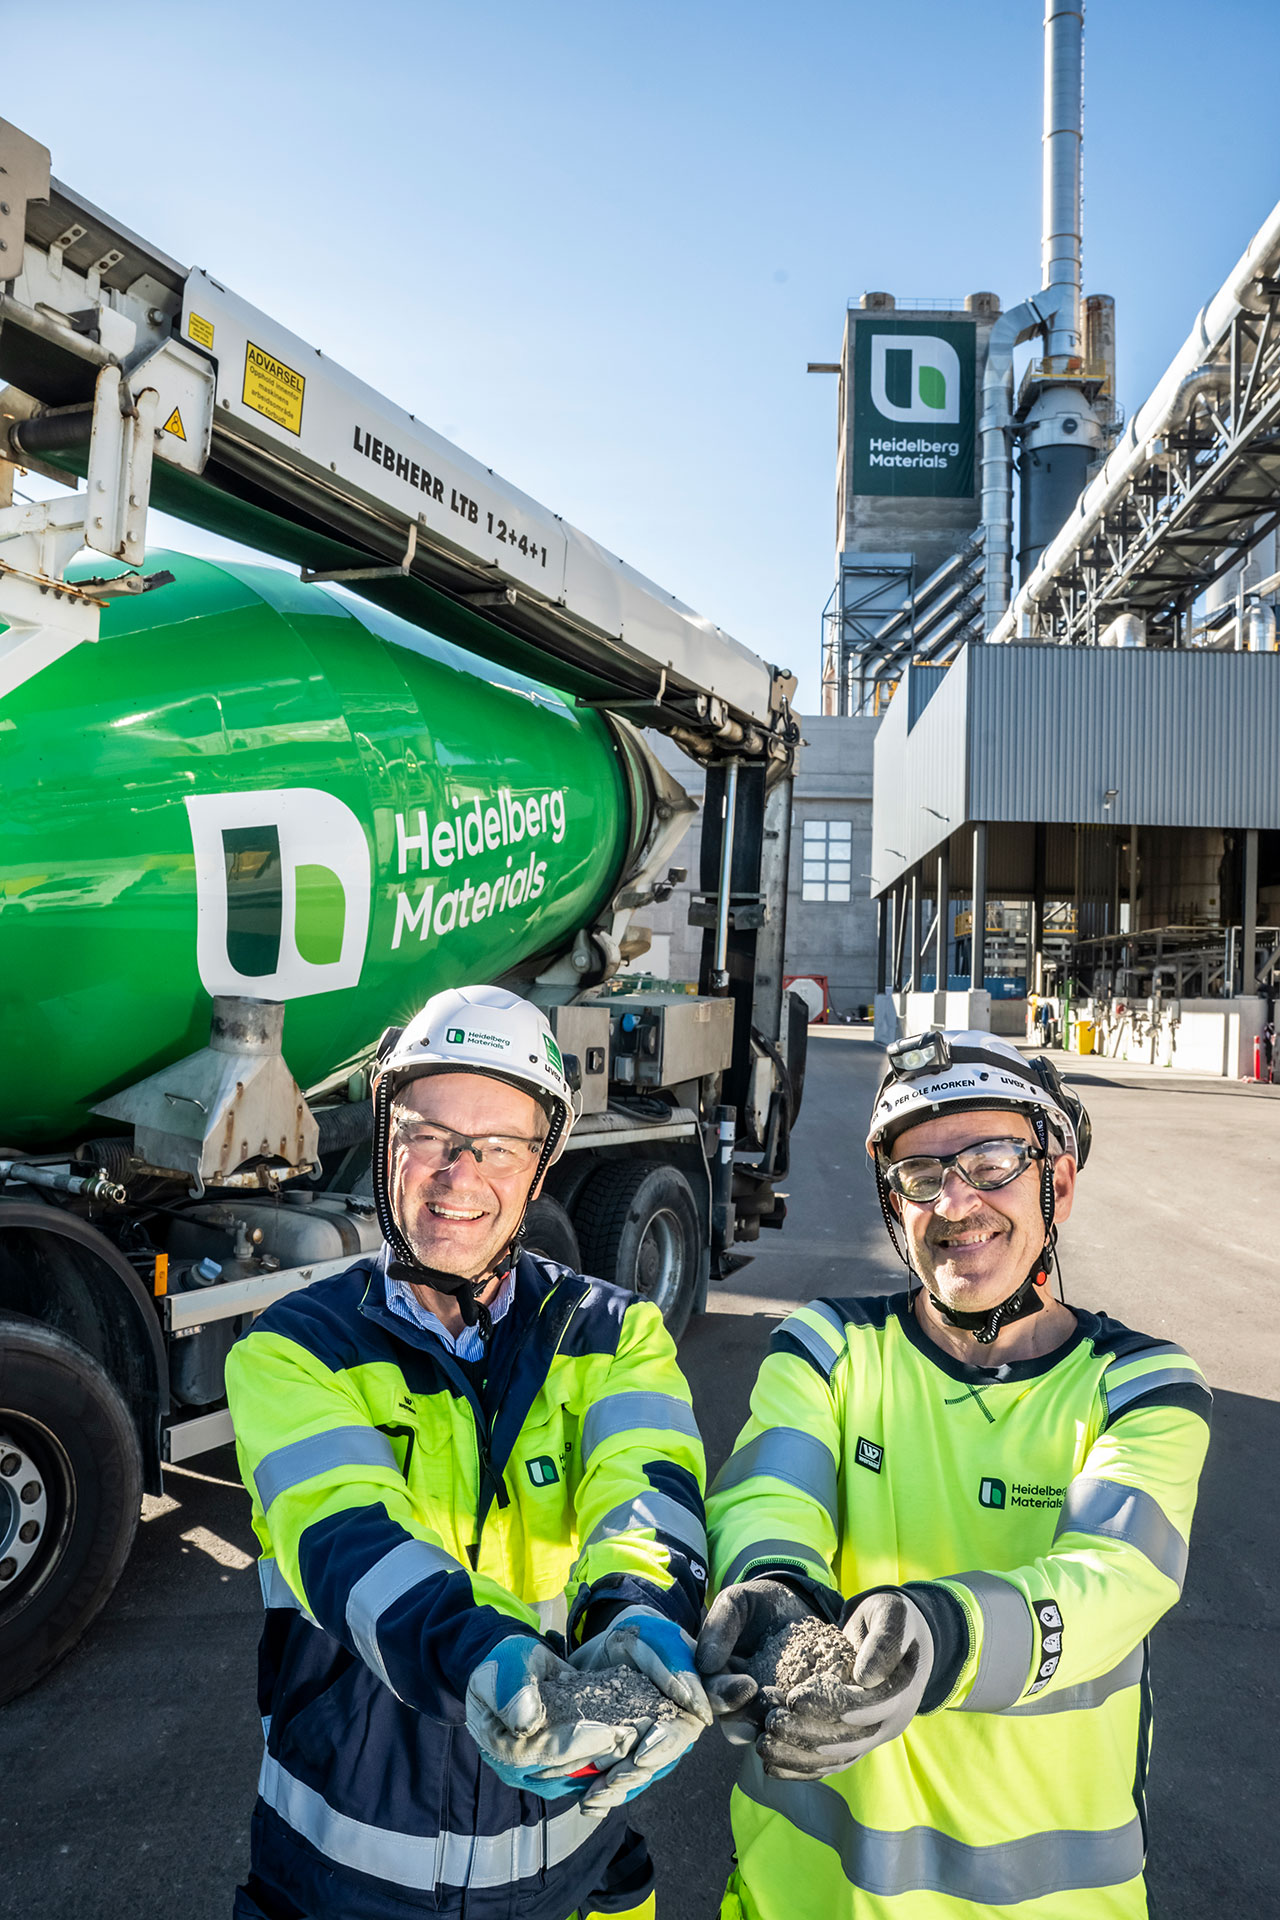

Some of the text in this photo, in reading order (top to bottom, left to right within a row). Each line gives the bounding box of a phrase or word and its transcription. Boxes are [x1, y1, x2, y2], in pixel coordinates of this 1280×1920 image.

[248, 349, 302, 392] ADVARSEL
[869, 437, 960, 456] Heidelberg
[869, 453, 948, 468] Materials
[353, 425, 547, 568] LIEBHERR LTB 12+4+1
[395, 788, 566, 875] Heidelberg
[390, 851, 548, 950] Materials
[467, 1037, 504, 1050] Materials
[468, 1031, 511, 1046] Heidelberg
[1000, 1076, 1026, 1090] uvex
[894, 1079, 975, 1107] PER OLE MORKEN
[1011, 1496, 1063, 1509] Materials
